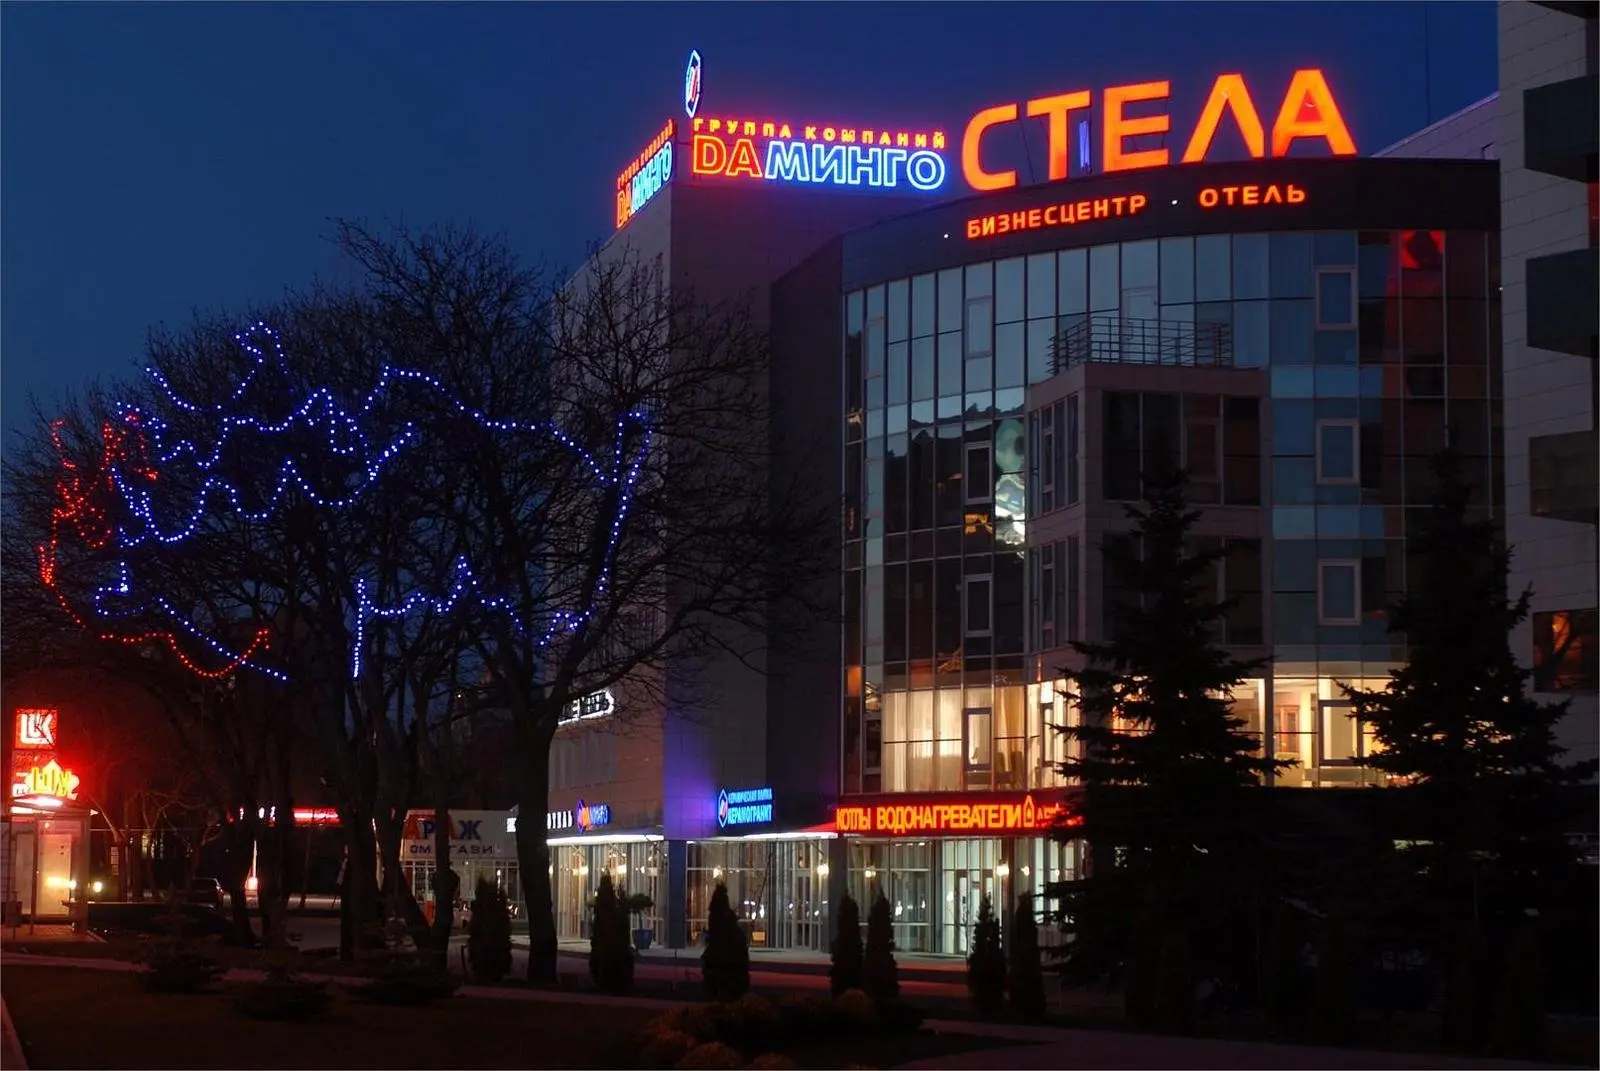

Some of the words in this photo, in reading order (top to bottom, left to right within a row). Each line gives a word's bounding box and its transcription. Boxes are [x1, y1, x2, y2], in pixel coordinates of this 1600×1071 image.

[693, 118, 792, 139] ГРУППА
[805, 126, 946, 149] КОМПАНИЙ
[961, 67, 1358, 192] СТЕЛА
[967, 194, 1147, 239] БИЗНЕСЦЕНТР
[1199, 183, 1306, 208] ОТЕЛЬ
[836, 807, 871, 830] КОТЛЫ
[876, 801, 1022, 834] ВОДОНАГРЕВАТЕЛИ
